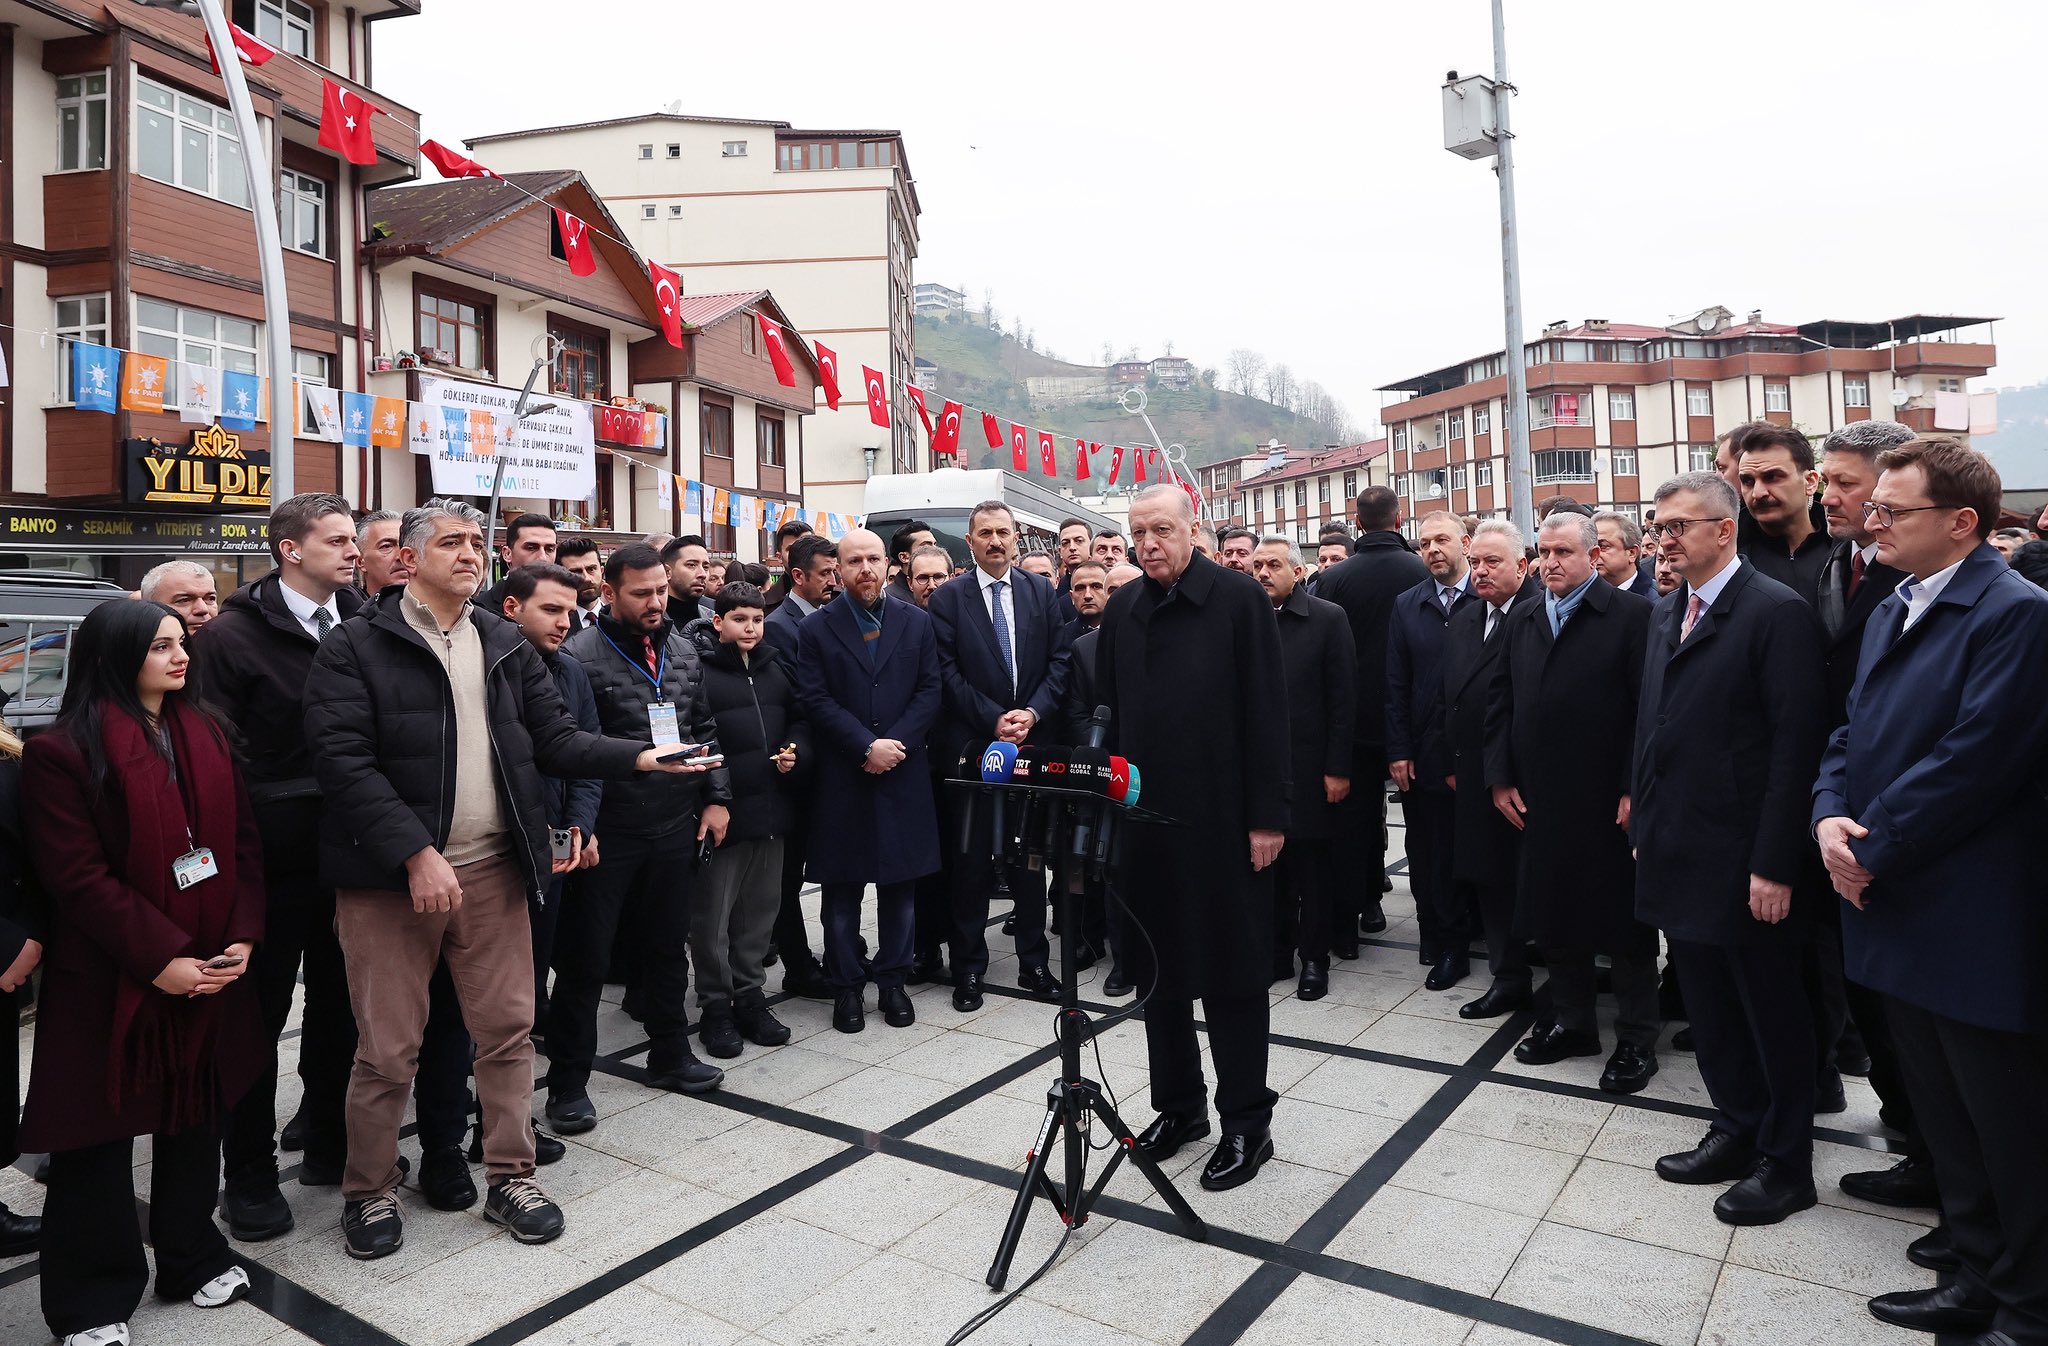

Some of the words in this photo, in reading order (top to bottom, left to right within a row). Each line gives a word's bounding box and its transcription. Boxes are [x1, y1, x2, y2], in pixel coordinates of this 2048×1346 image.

[128, 387, 140, 395] AK
[142, 390, 163, 398] PART
[443, 389, 478, 404] GÖKLERDE
[164, 446, 178, 455] BY
[481, 455, 490, 464] EY
[521, 458, 534, 468] ANA
[535, 459, 552, 469] BABA
[475, 474, 518, 490] TÜVA
[10, 517, 57, 533] BANYO
[83, 518, 133, 535] SERAMİK
[155, 519, 203, 537] VİTRİFİYE
[221, 524, 247, 538] BOYA
[188, 541, 221, 550] Mimari
[222, 540, 259, 551] Zarafetin
[984, 751, 1004, 772] AA
[1015, 759, 1031, 769] TRT
